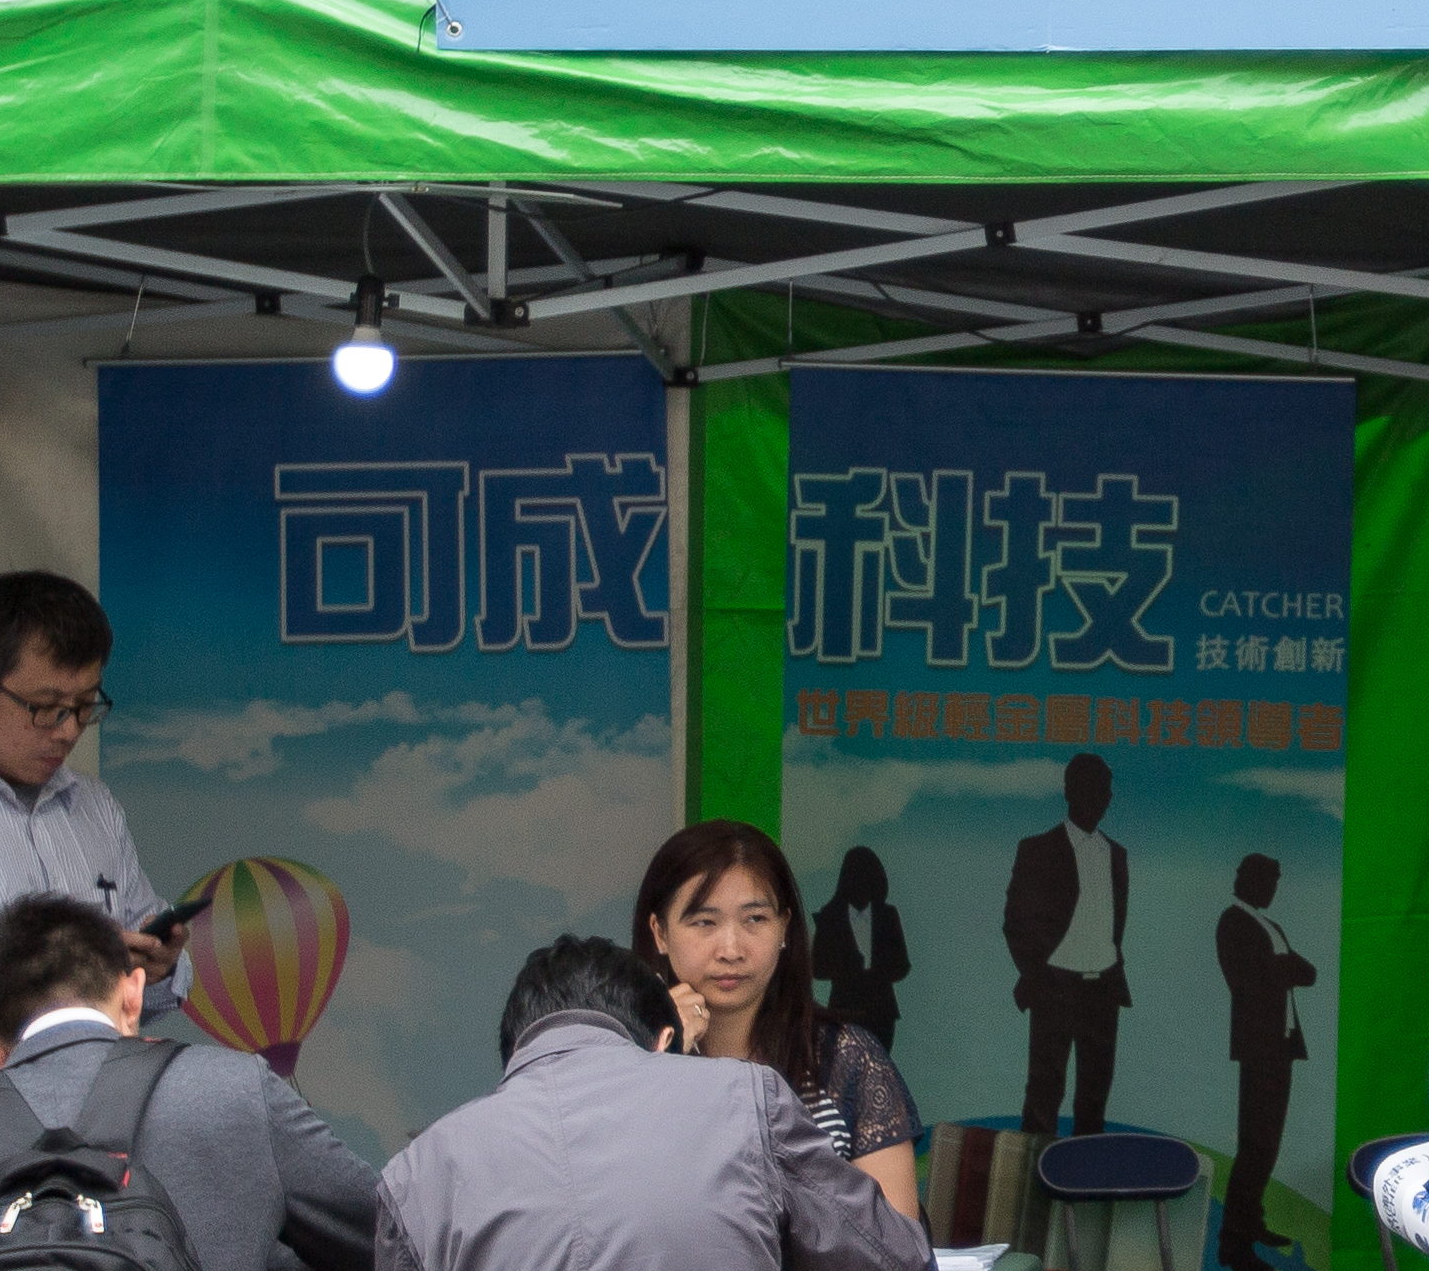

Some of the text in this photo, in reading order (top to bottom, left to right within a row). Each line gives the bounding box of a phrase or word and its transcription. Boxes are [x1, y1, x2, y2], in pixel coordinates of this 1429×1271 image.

[273, 452, 670, 652] 可成
[786, 466, 1179, 673] 科技
[1199, 589, 1345, 620] CATCHER
[1195, 633, 1347, 673] 技術創新
[795, 687, 1344, 751] 世界級輕金屬科技領導者
